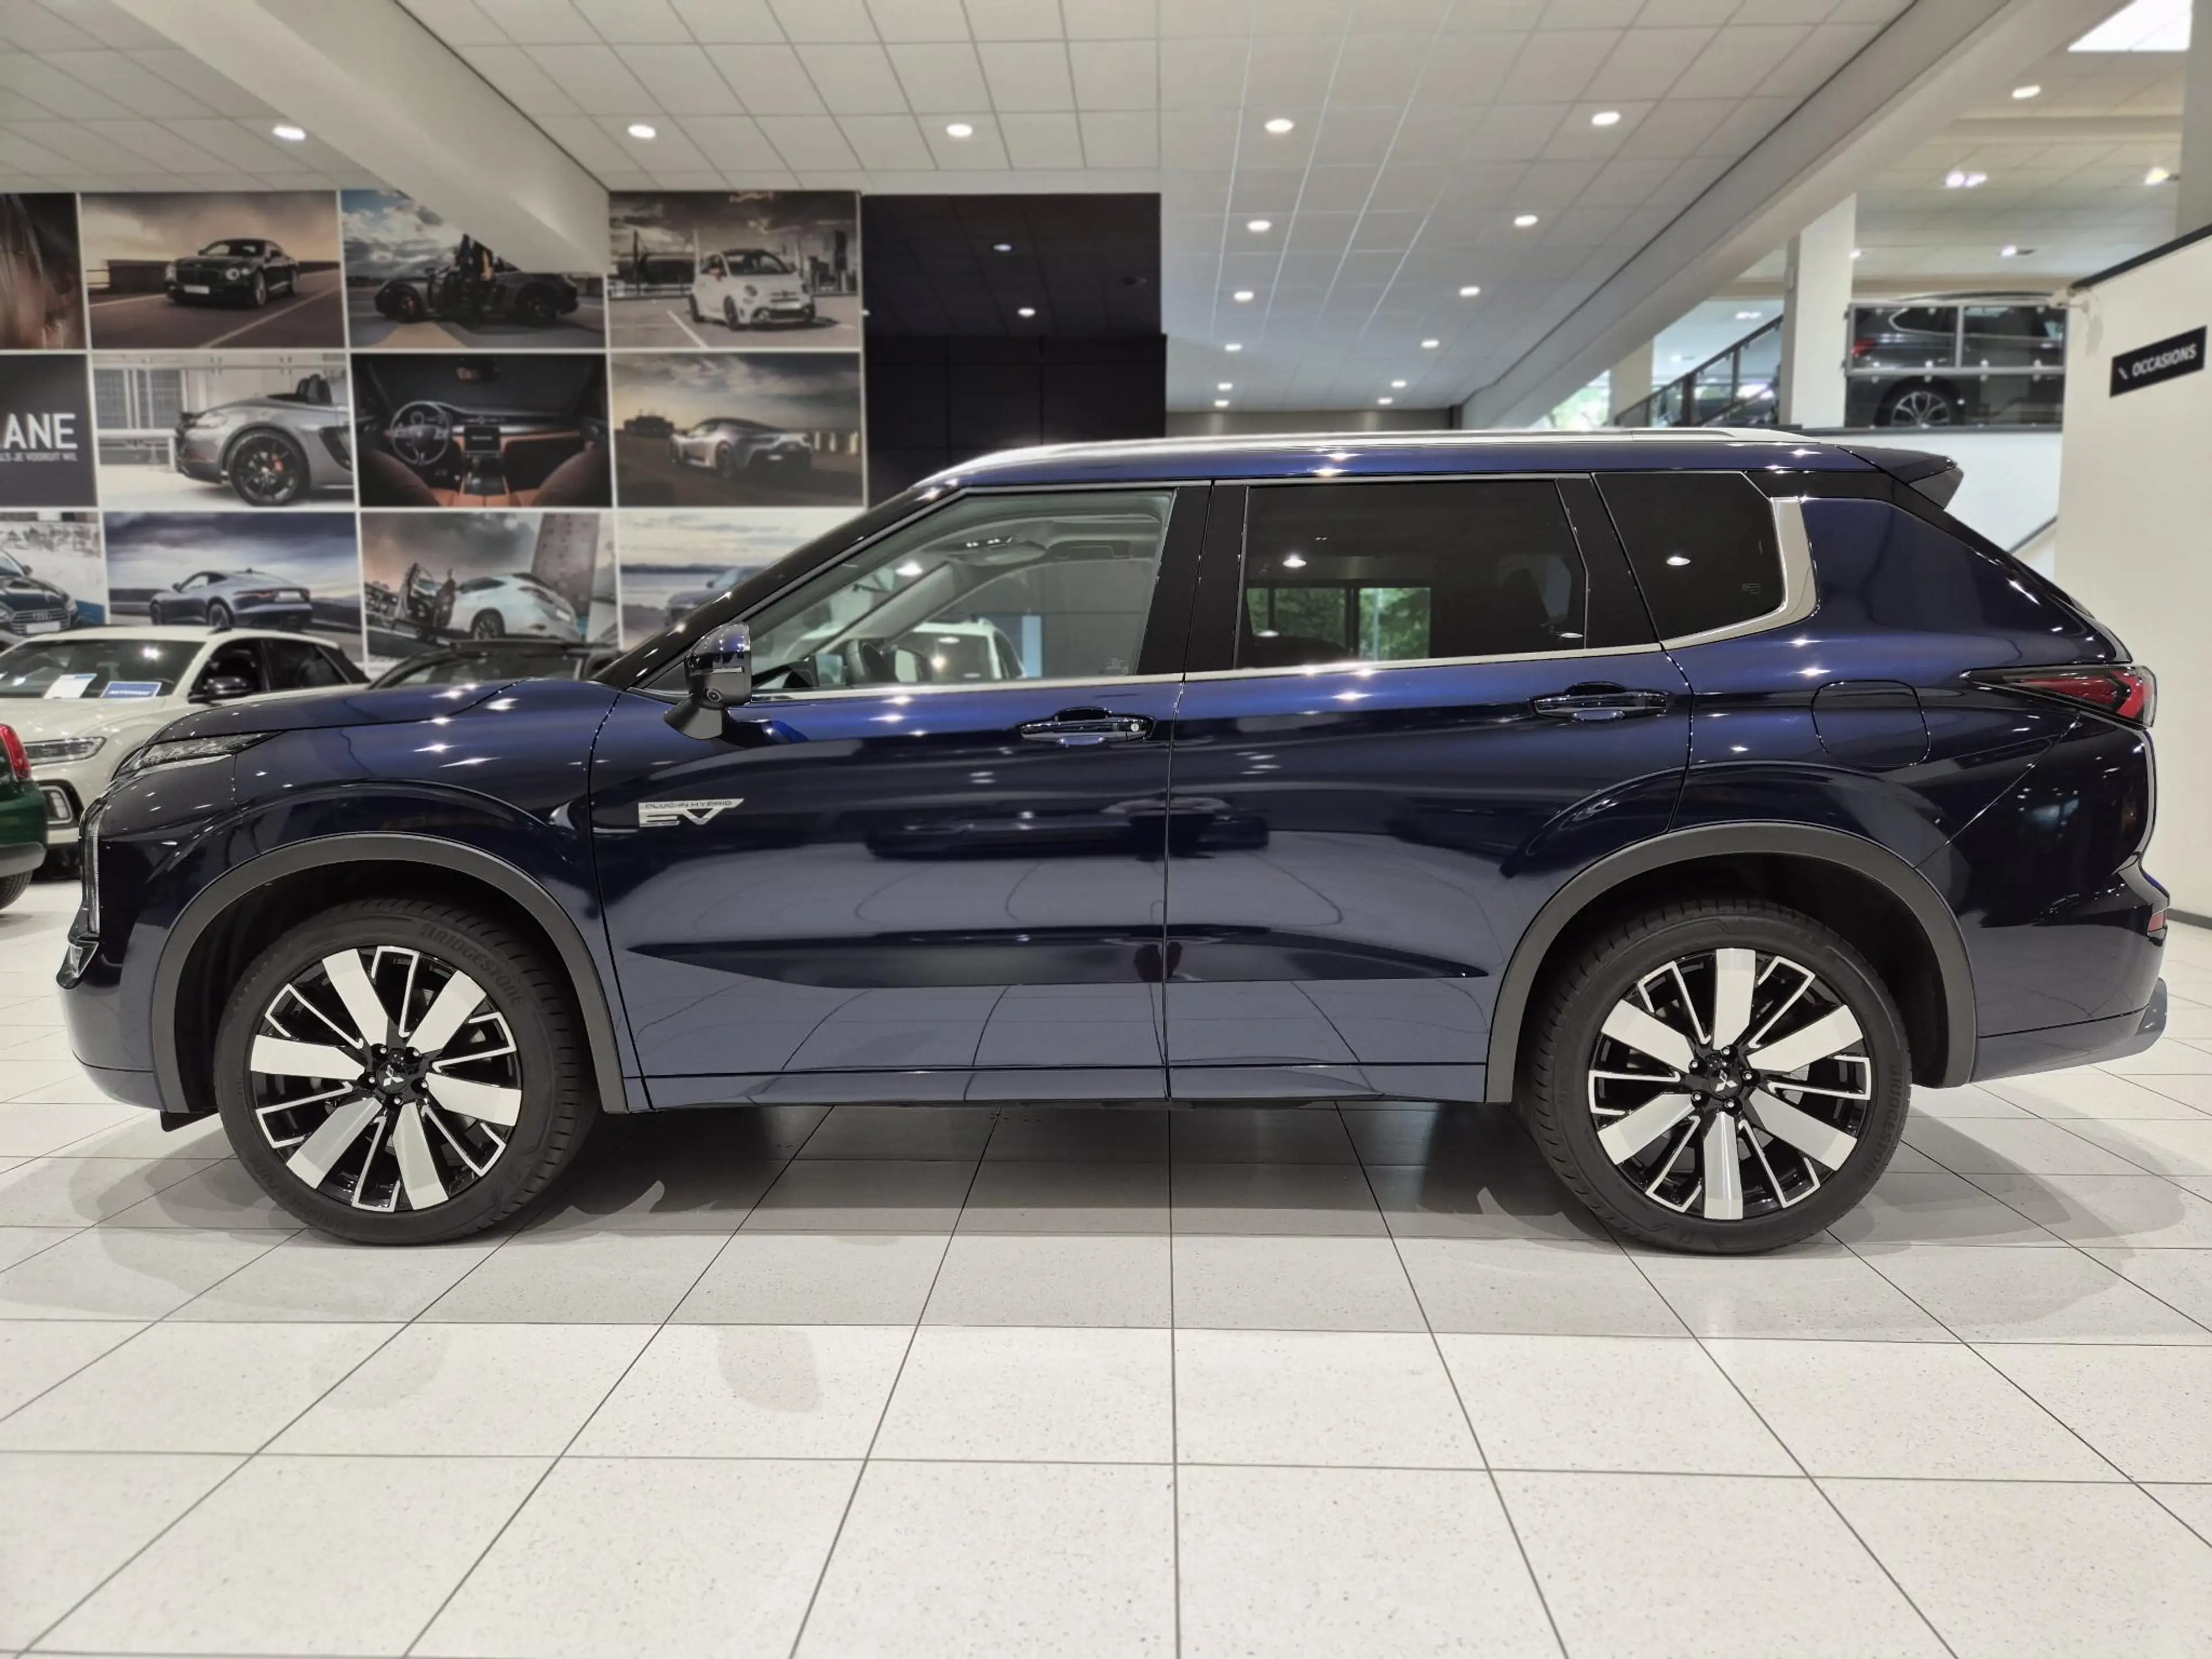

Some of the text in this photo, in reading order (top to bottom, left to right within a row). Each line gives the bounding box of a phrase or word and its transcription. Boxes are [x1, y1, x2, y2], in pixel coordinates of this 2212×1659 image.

[2132, 343, 2196, 377] OCCASIONS
[0, 412, 78, 450] ANE
[638, 804, 740, 827] EV
[418, 922, 524, 1004] BRIDGESTONE
